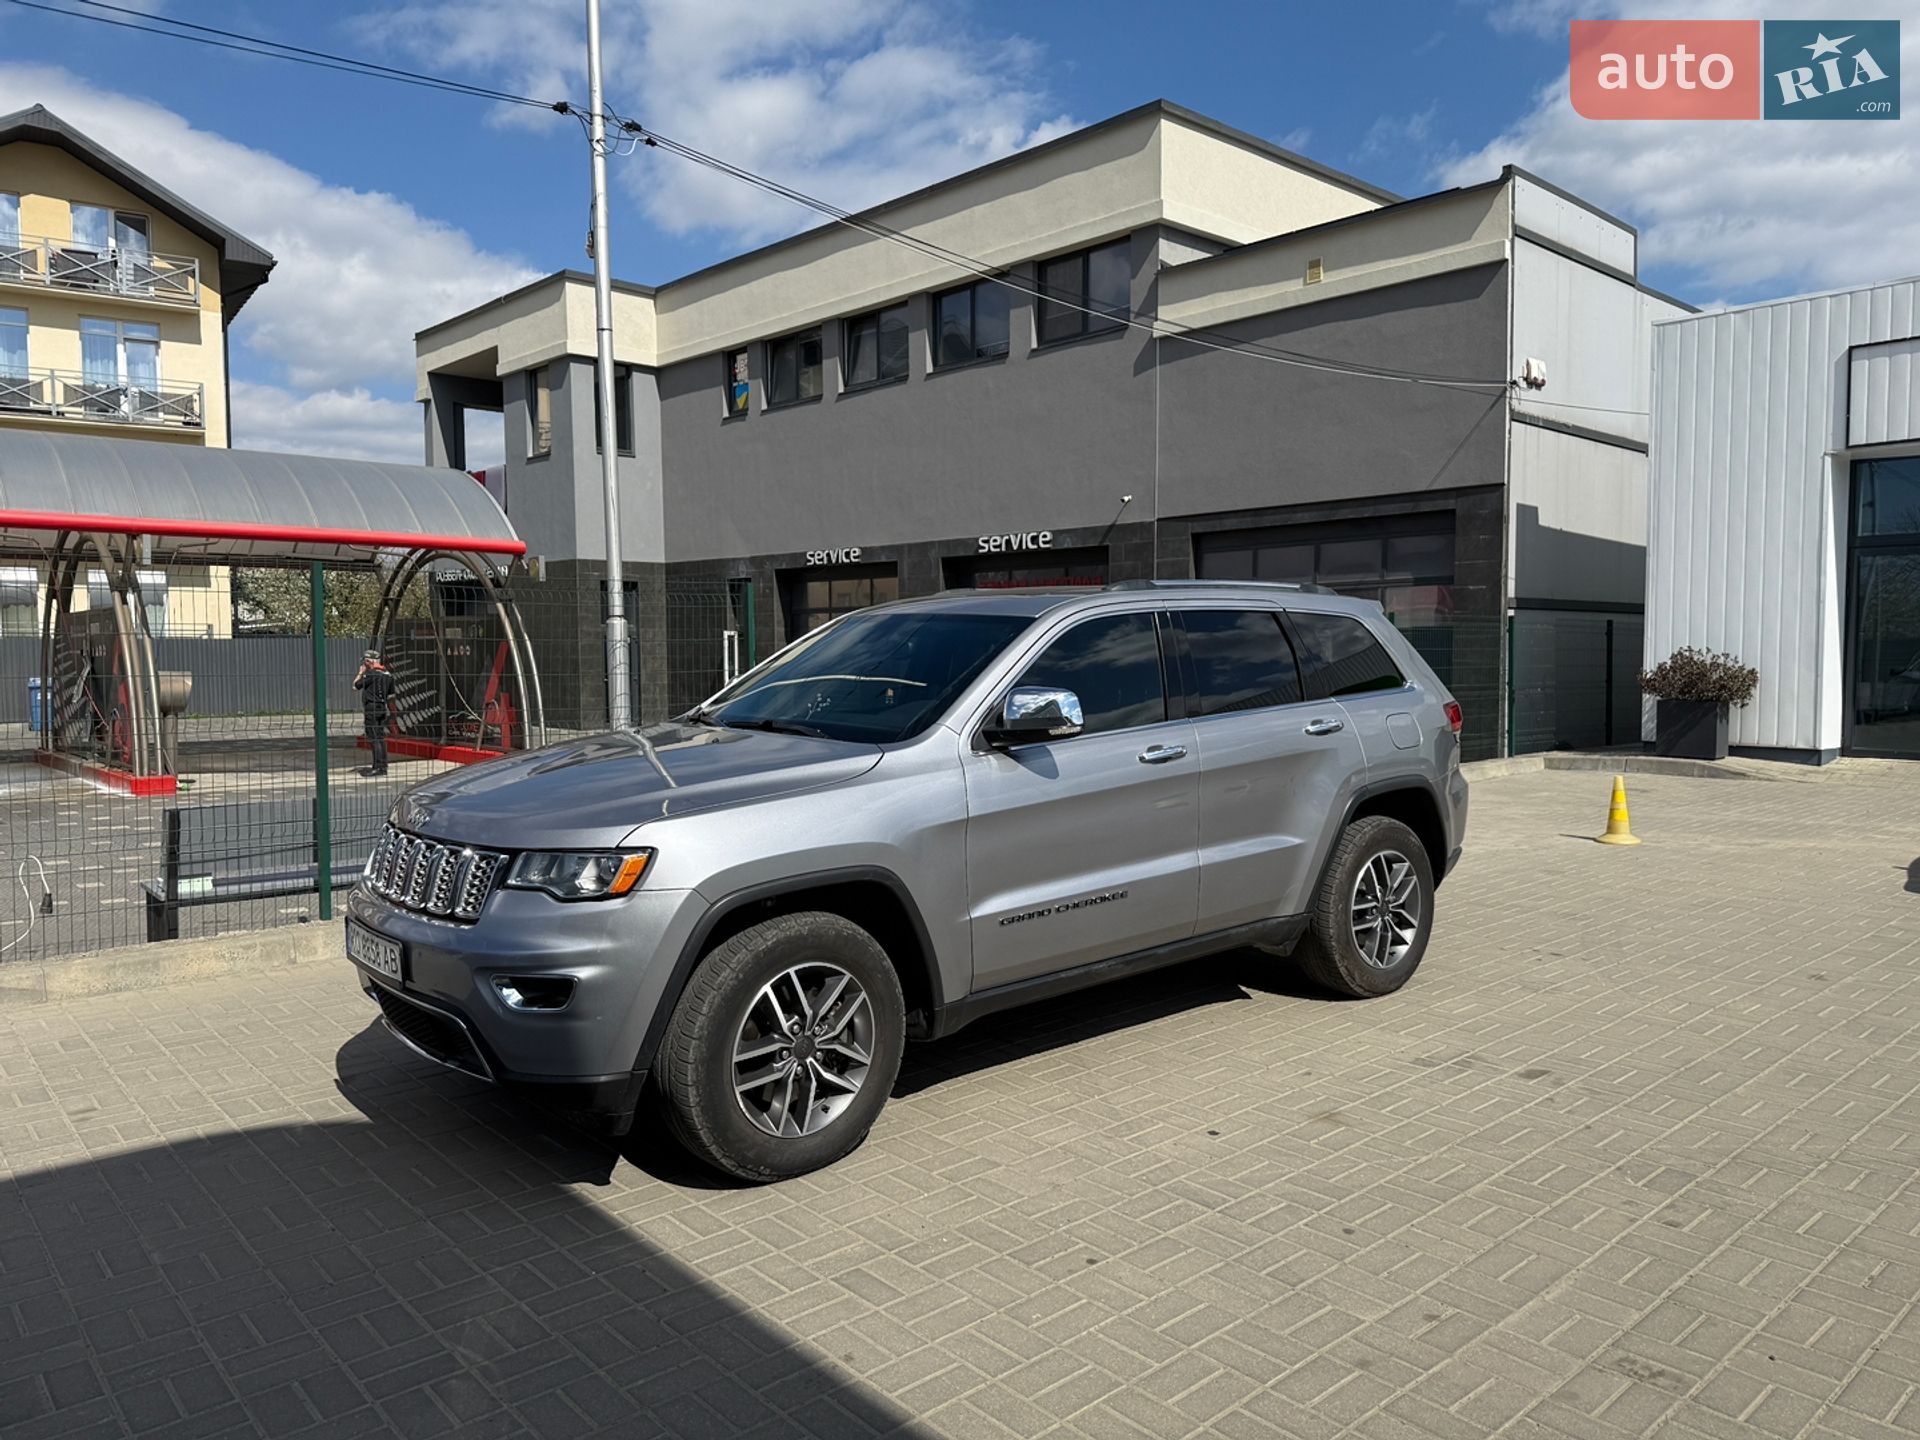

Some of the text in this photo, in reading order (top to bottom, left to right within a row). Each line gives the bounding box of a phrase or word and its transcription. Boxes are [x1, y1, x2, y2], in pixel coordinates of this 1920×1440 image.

[978, 530, 1053, 553] service
[806, 547, 861, 566] service
[999, 890, 1129, 926] GRAND CHEROKEE
[383, 945, 399, 974] AB
